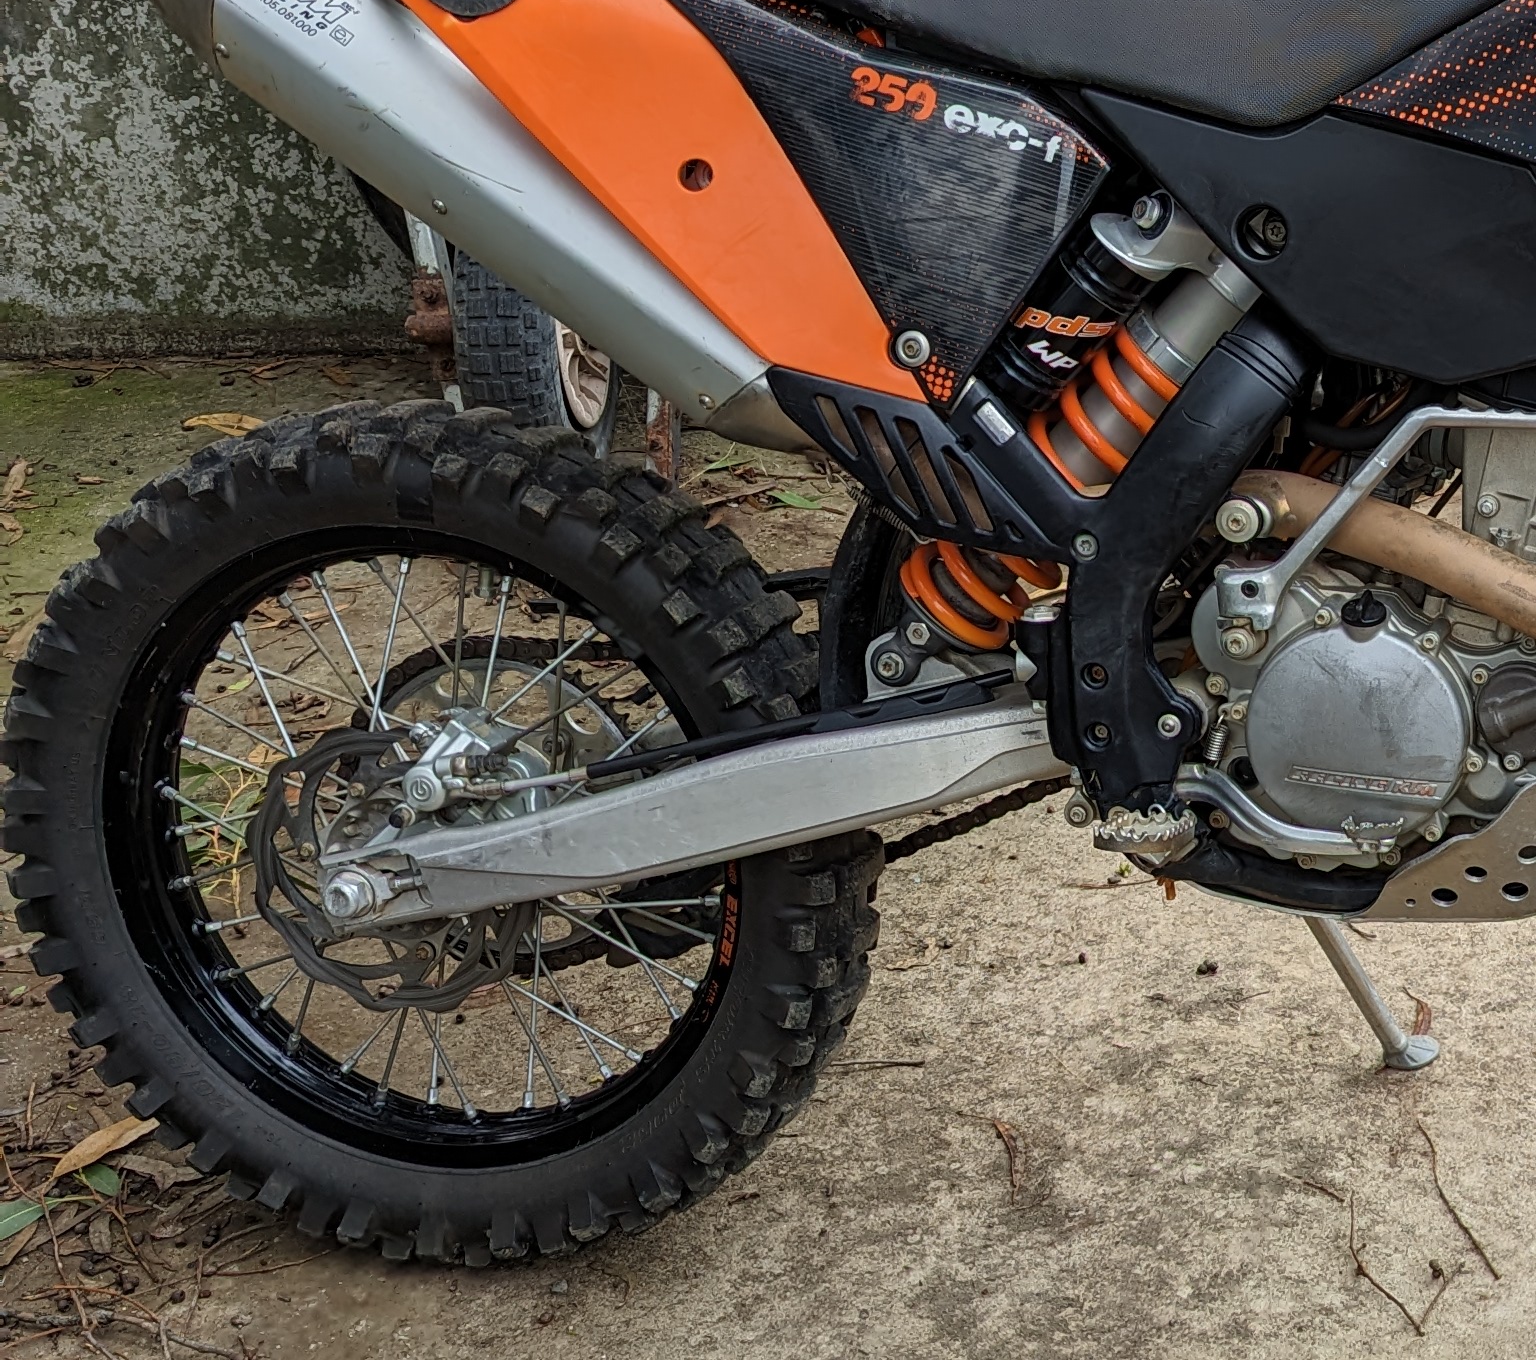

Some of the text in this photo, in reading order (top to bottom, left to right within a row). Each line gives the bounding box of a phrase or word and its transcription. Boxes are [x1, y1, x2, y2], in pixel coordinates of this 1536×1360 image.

[1014, 307, 1117, 338] pds
[1027, 340, 1079, 369] WP
[719, 893, 738, 967] EXCEL
